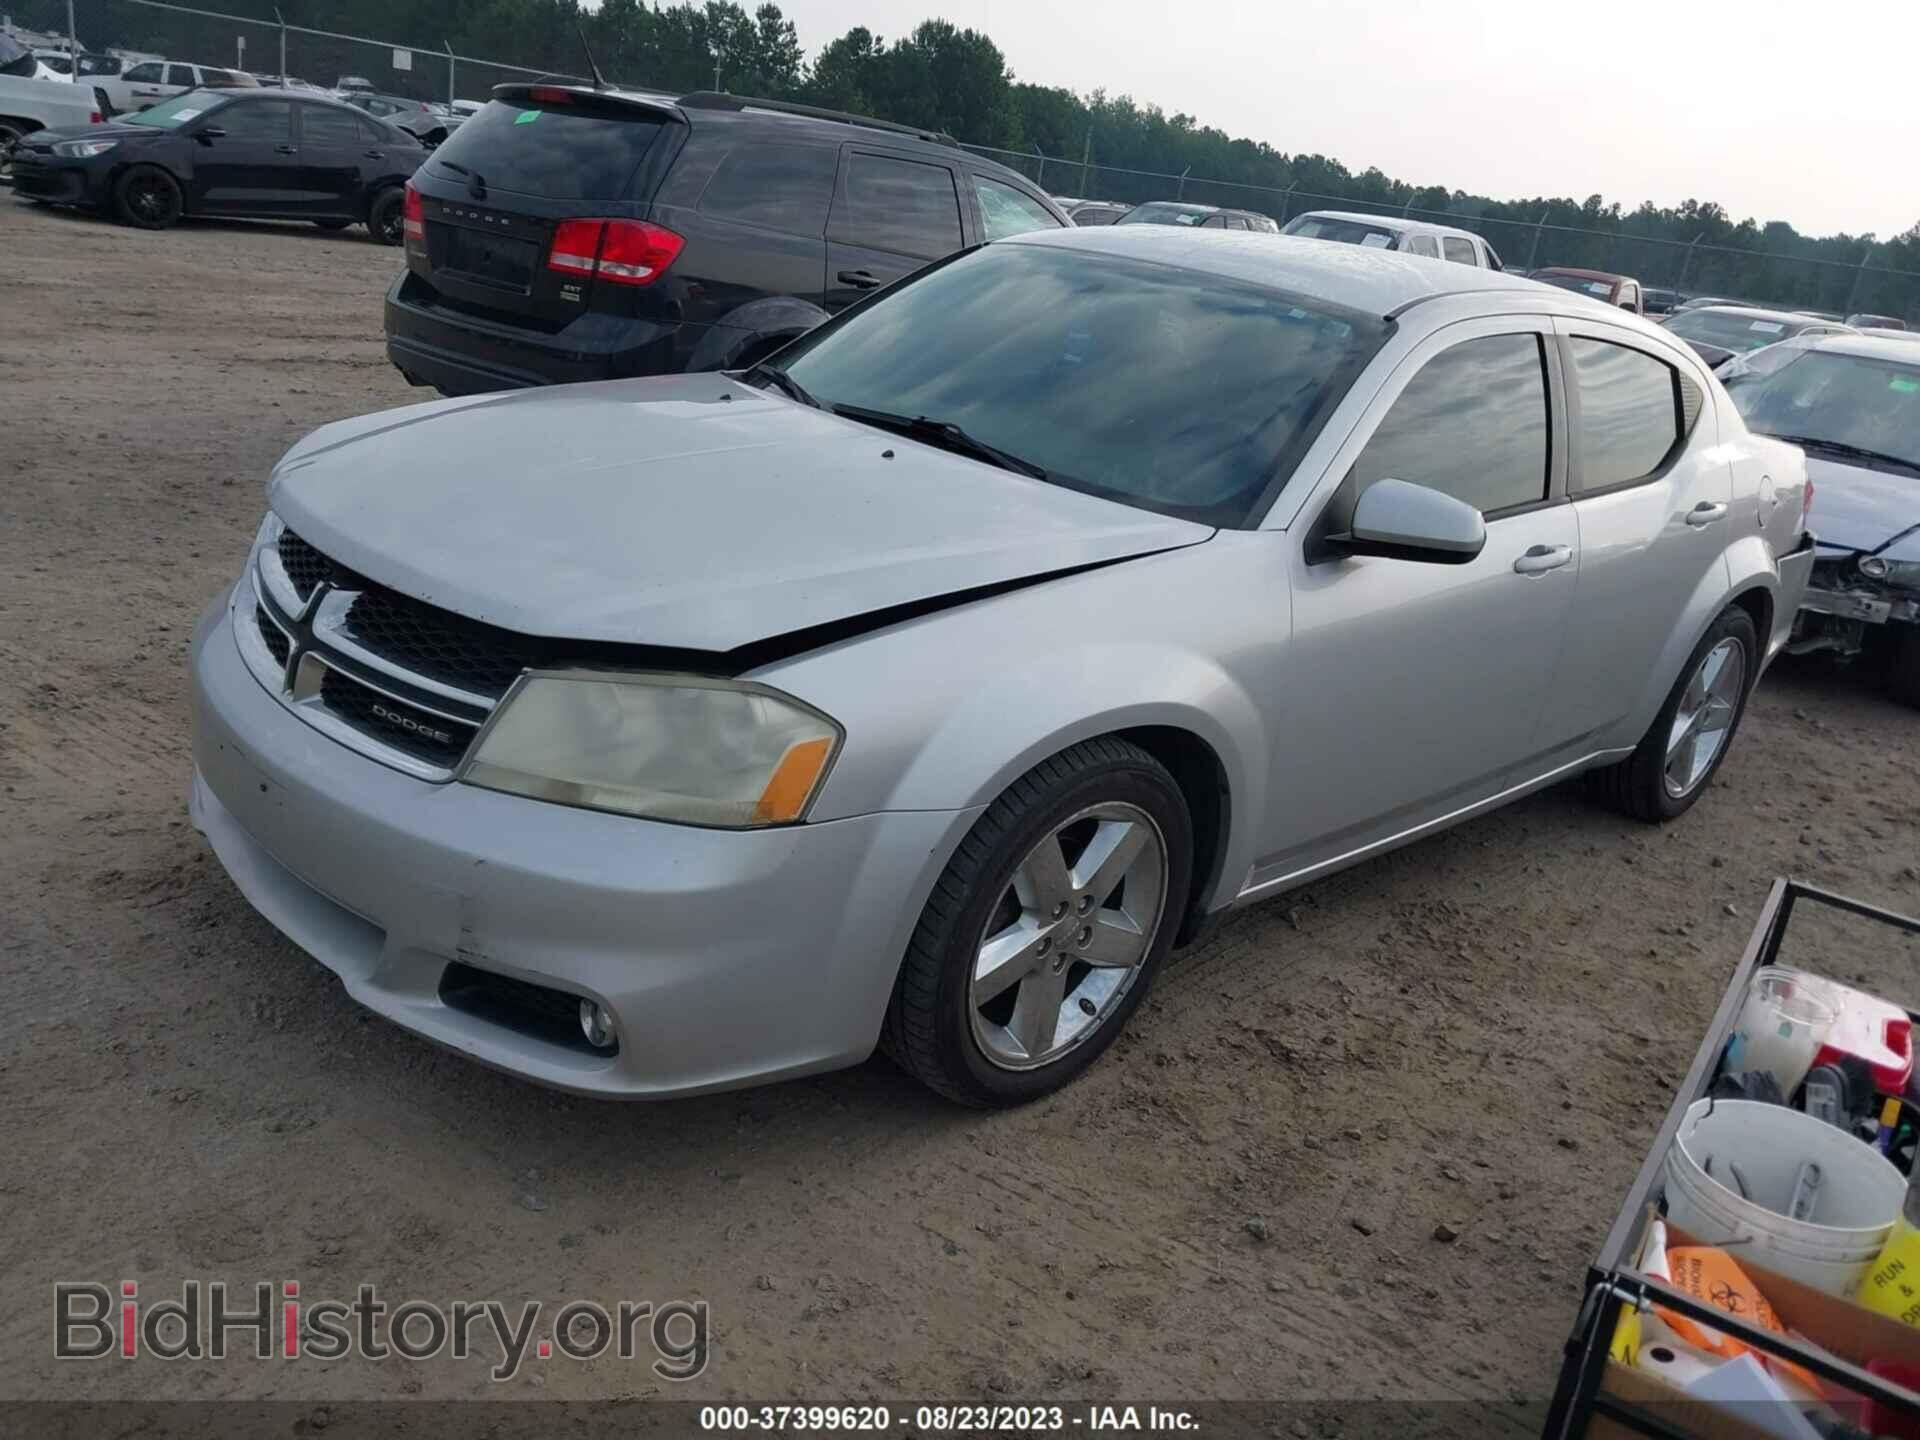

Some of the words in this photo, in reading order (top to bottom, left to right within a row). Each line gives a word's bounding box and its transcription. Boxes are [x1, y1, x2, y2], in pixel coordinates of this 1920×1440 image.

[372, 704, 450, 743] DODGE
[1873, 1258, 1906, 1288] RUN
[1900, 1285, 1914, 1297] &
